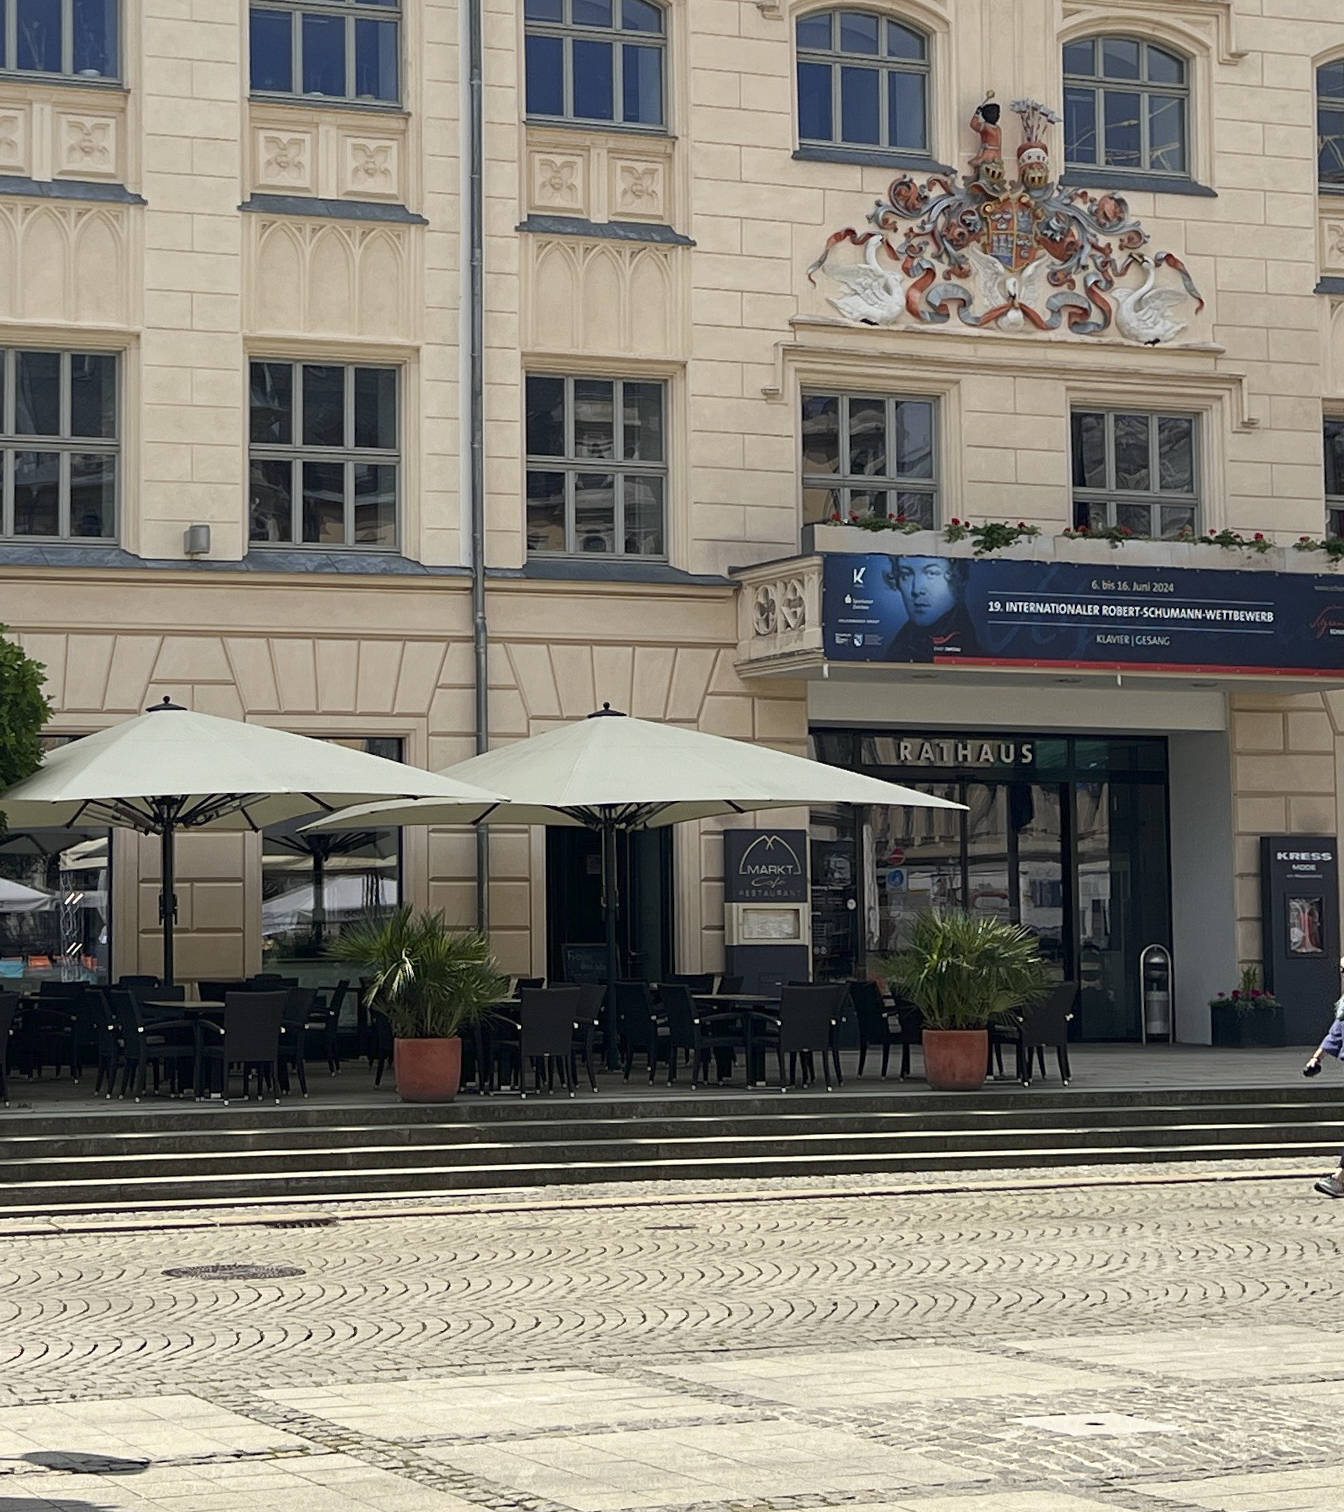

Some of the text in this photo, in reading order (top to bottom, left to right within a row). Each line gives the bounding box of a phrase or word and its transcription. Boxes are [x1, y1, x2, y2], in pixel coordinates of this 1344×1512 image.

[1091, 579, 1174, 593] 6. bis 16. Juni 2024
[988, 600, 1274, 622] 19. INTERNATIONALER ROBERT-SCHUMANN-WETTBEWERB
[1096, 634, 1171, 646] KLAVIER GESANG
[899, 741, 1033, 764] RATHAUS
[1276, 851, 1333, 862] KRESS
[746, 864, 794, 875] MARKT
[1291, 863, 1317, 872] MODE
[738, 889, 802, 898] RESTAURANT
